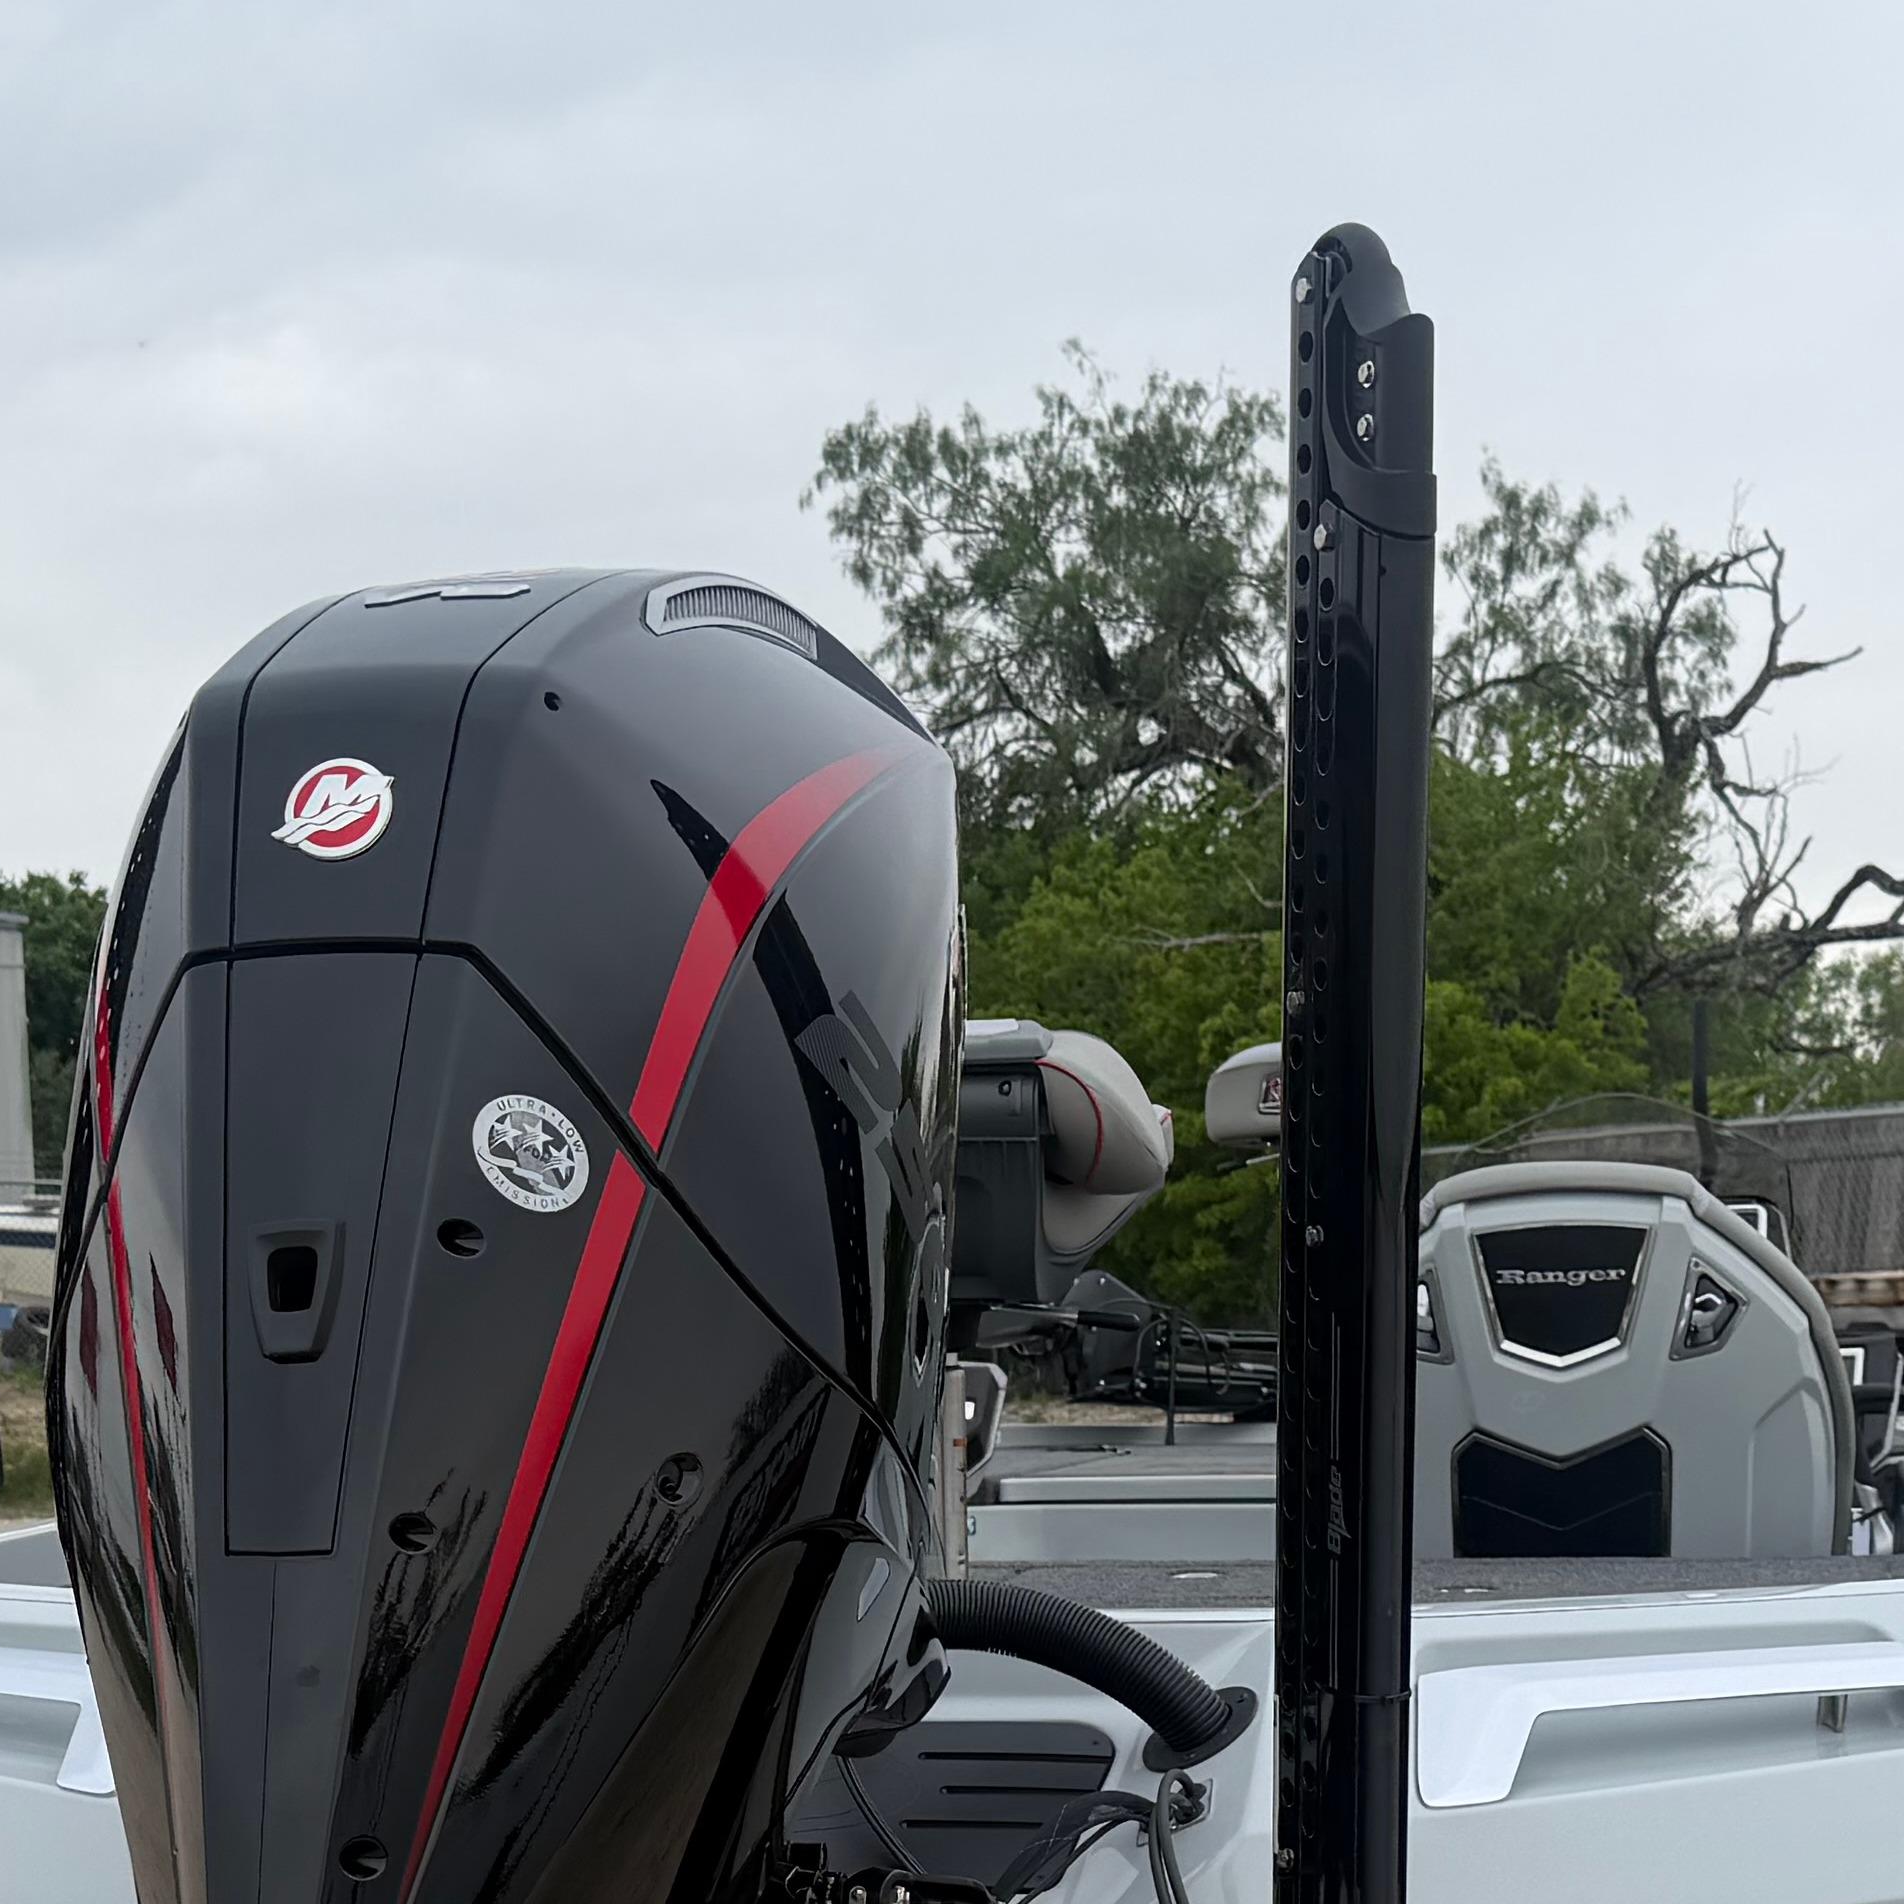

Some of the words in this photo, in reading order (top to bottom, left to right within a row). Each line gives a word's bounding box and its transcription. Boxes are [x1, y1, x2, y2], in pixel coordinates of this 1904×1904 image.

[496, 1099, 546, 1116] ULTRA
[557, 1118, 585, 1153] LOW
[1495, 1268, 1627, 1287] Ranger
[1326, 1465, 1353, 1556] Blade
